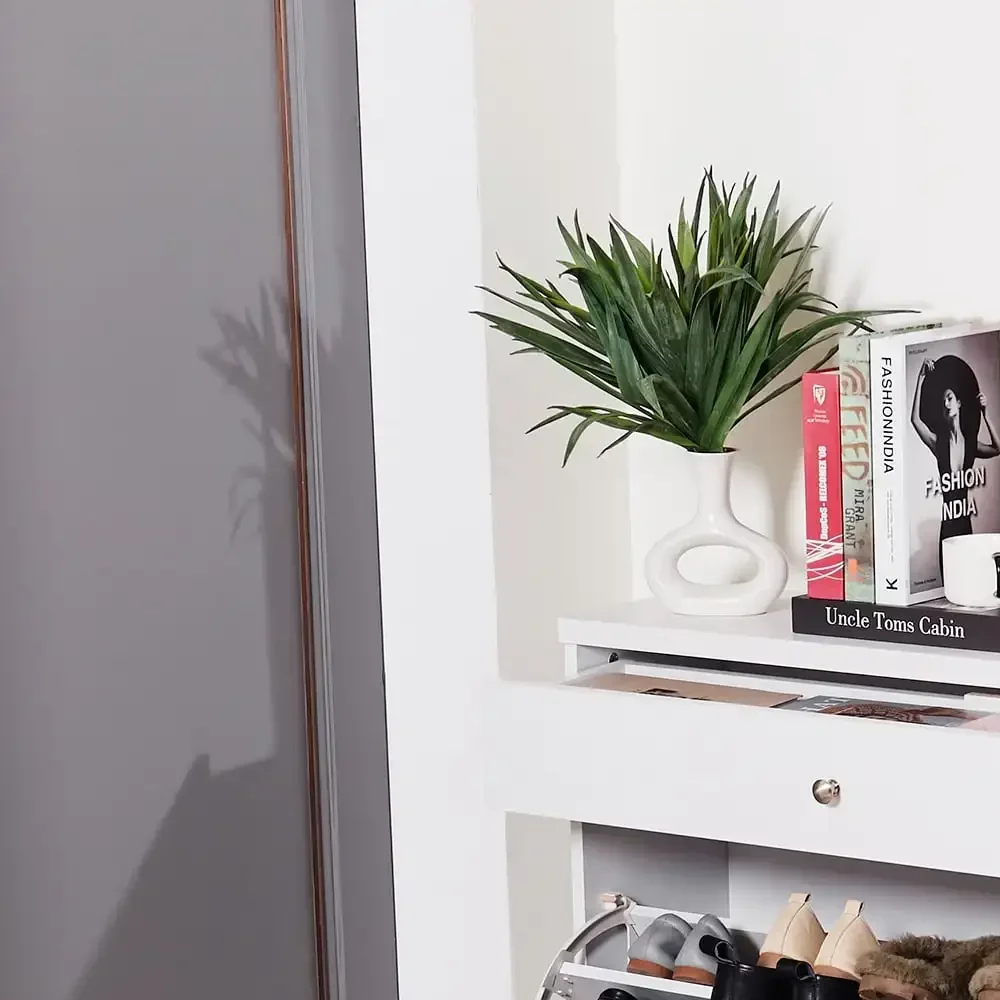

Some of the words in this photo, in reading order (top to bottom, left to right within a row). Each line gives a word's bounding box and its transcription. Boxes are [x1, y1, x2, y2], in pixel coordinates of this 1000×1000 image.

[881, 357, 894, 474] FASHIONINDIA
[841, 406, 869, 481] FEED
[924, 466, 986, 498] FASHION
[854, 488, 865, 522] MIRA
[941, 498, 977, 522] INDIA
[845, 507, 856, 549] GRANT
[885, 577, 898, 590] K
[825, 606, 870, 629] Uncle
[873, 611, 915, 634] Toms
[919, 616, 965, 639] Cabin
